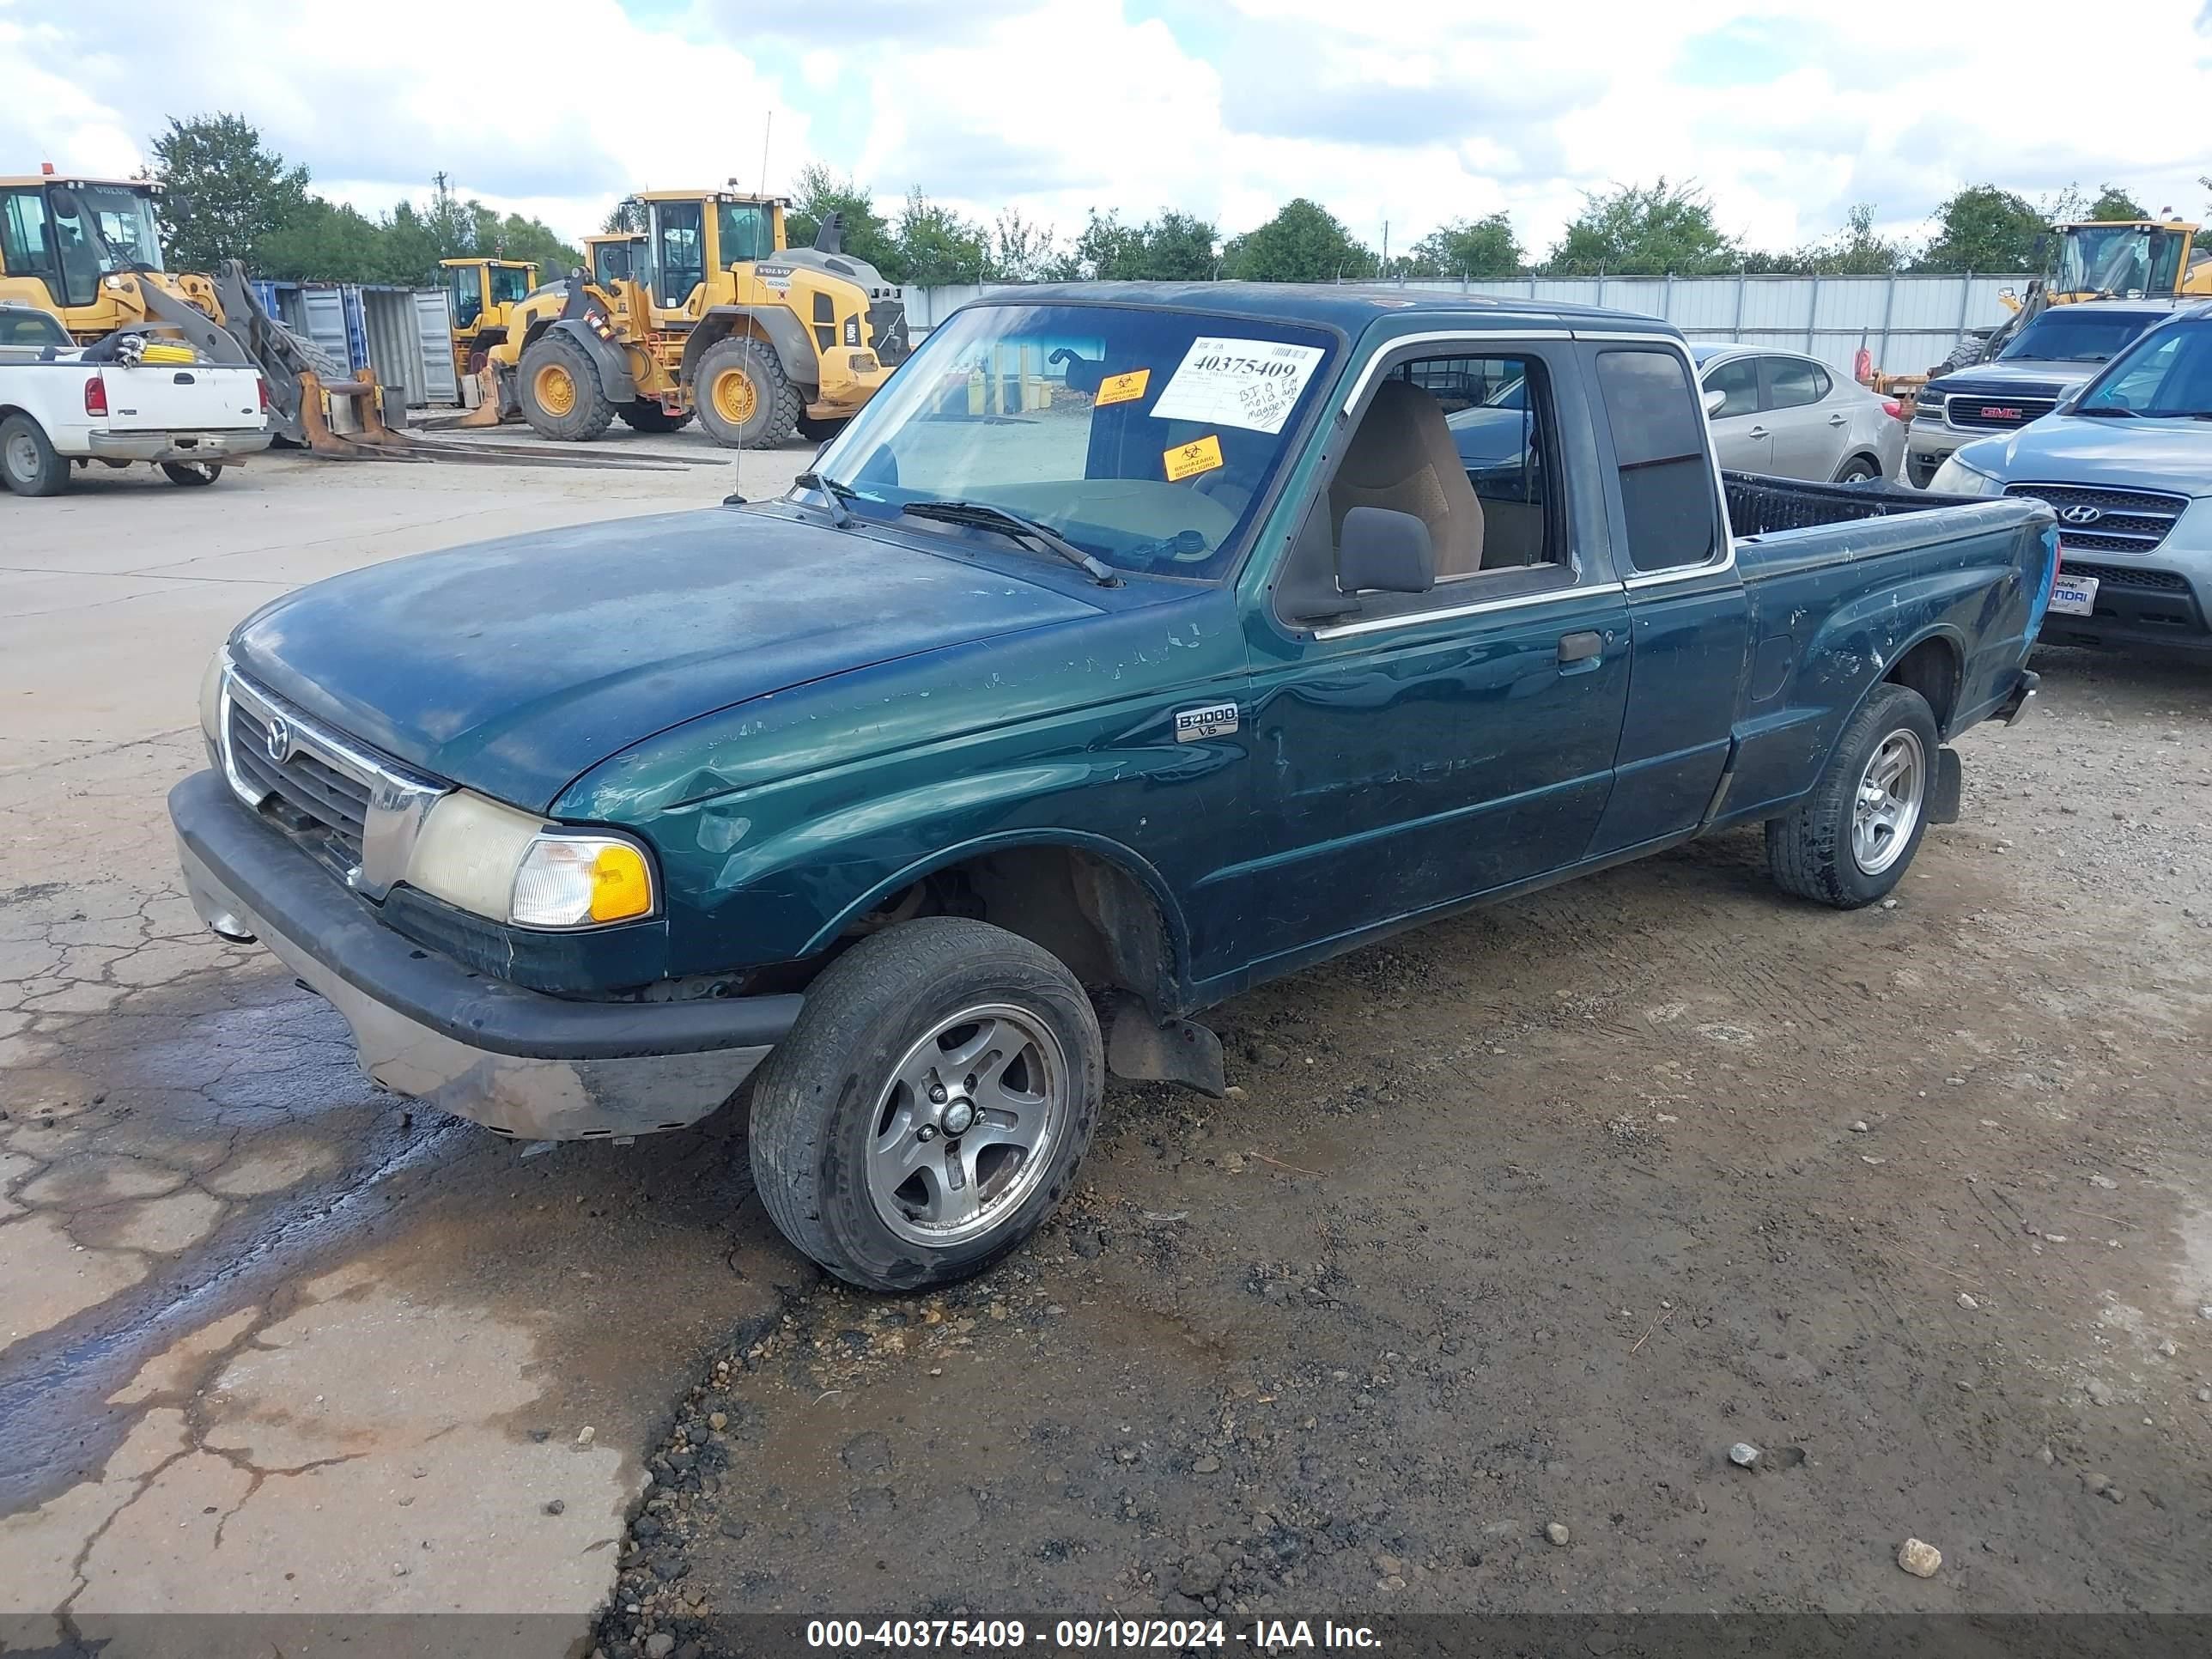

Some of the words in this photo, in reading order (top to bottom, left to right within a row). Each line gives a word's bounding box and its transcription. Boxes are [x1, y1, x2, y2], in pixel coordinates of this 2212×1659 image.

[847, 324, 856, 343] L90H
[1194, 356, 1297, 379] 40375409
[1981, 407, 2022, 418] GMC
[1175, 456, 1214, 471] BIOHAZARD
[2055, 590, 2087, 602] NDAI
[1180, 708, 1235, 728] B4000
[1199, 726, 1217, 736] V6
